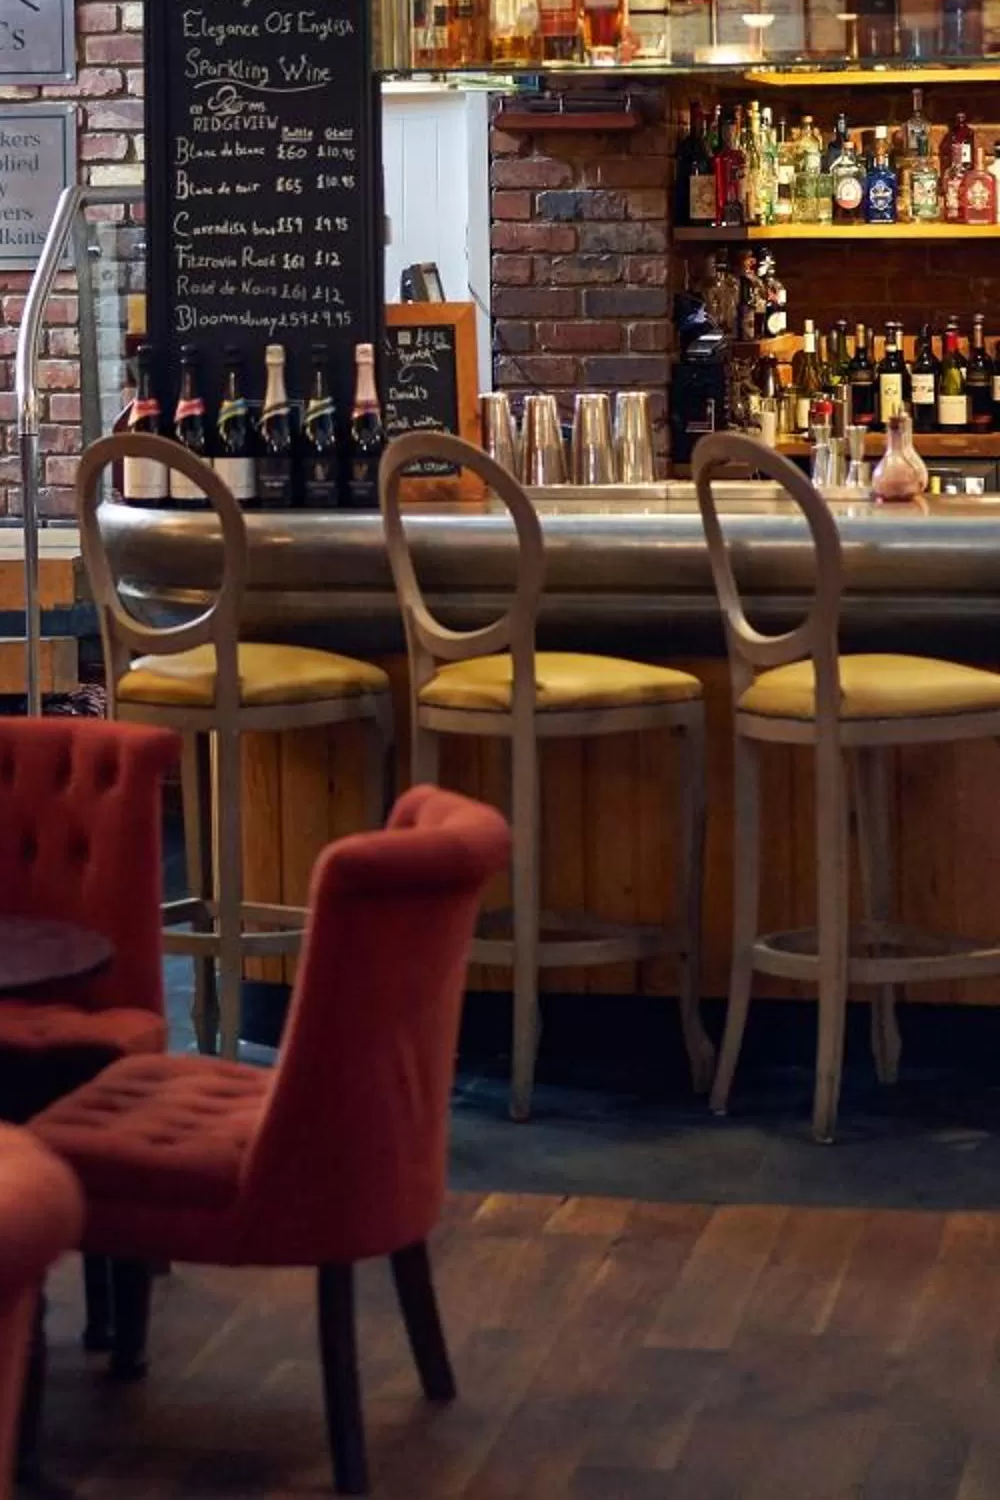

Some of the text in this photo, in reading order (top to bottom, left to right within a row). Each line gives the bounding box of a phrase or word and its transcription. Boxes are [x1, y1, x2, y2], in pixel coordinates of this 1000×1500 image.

[182, 8, 355, 46] Elegance Of English
[278, 53, 333, 82] Wine
[192, 114, 280, 133] RIDGEVIEW
[173, 136, 217, 165] Blanc
[276, 144, 308, 160] £60
[174, 169, 214, 200] Blanc
[217, 180, 231, 195] de
[275, 176, 304, 195] £65
[172, 211, 248, 237] Cavendish
[277, 216, 304, 234] £59
[174, 243, 237, 270] Fitzrovia
[281, 252, 306, 270] £61
[314, 249, 342, 267] £12
[218, 280, 236, 295] de
[312, 287, 345, 305] £12
[173, 305, 279, 337] Bloomsbury
